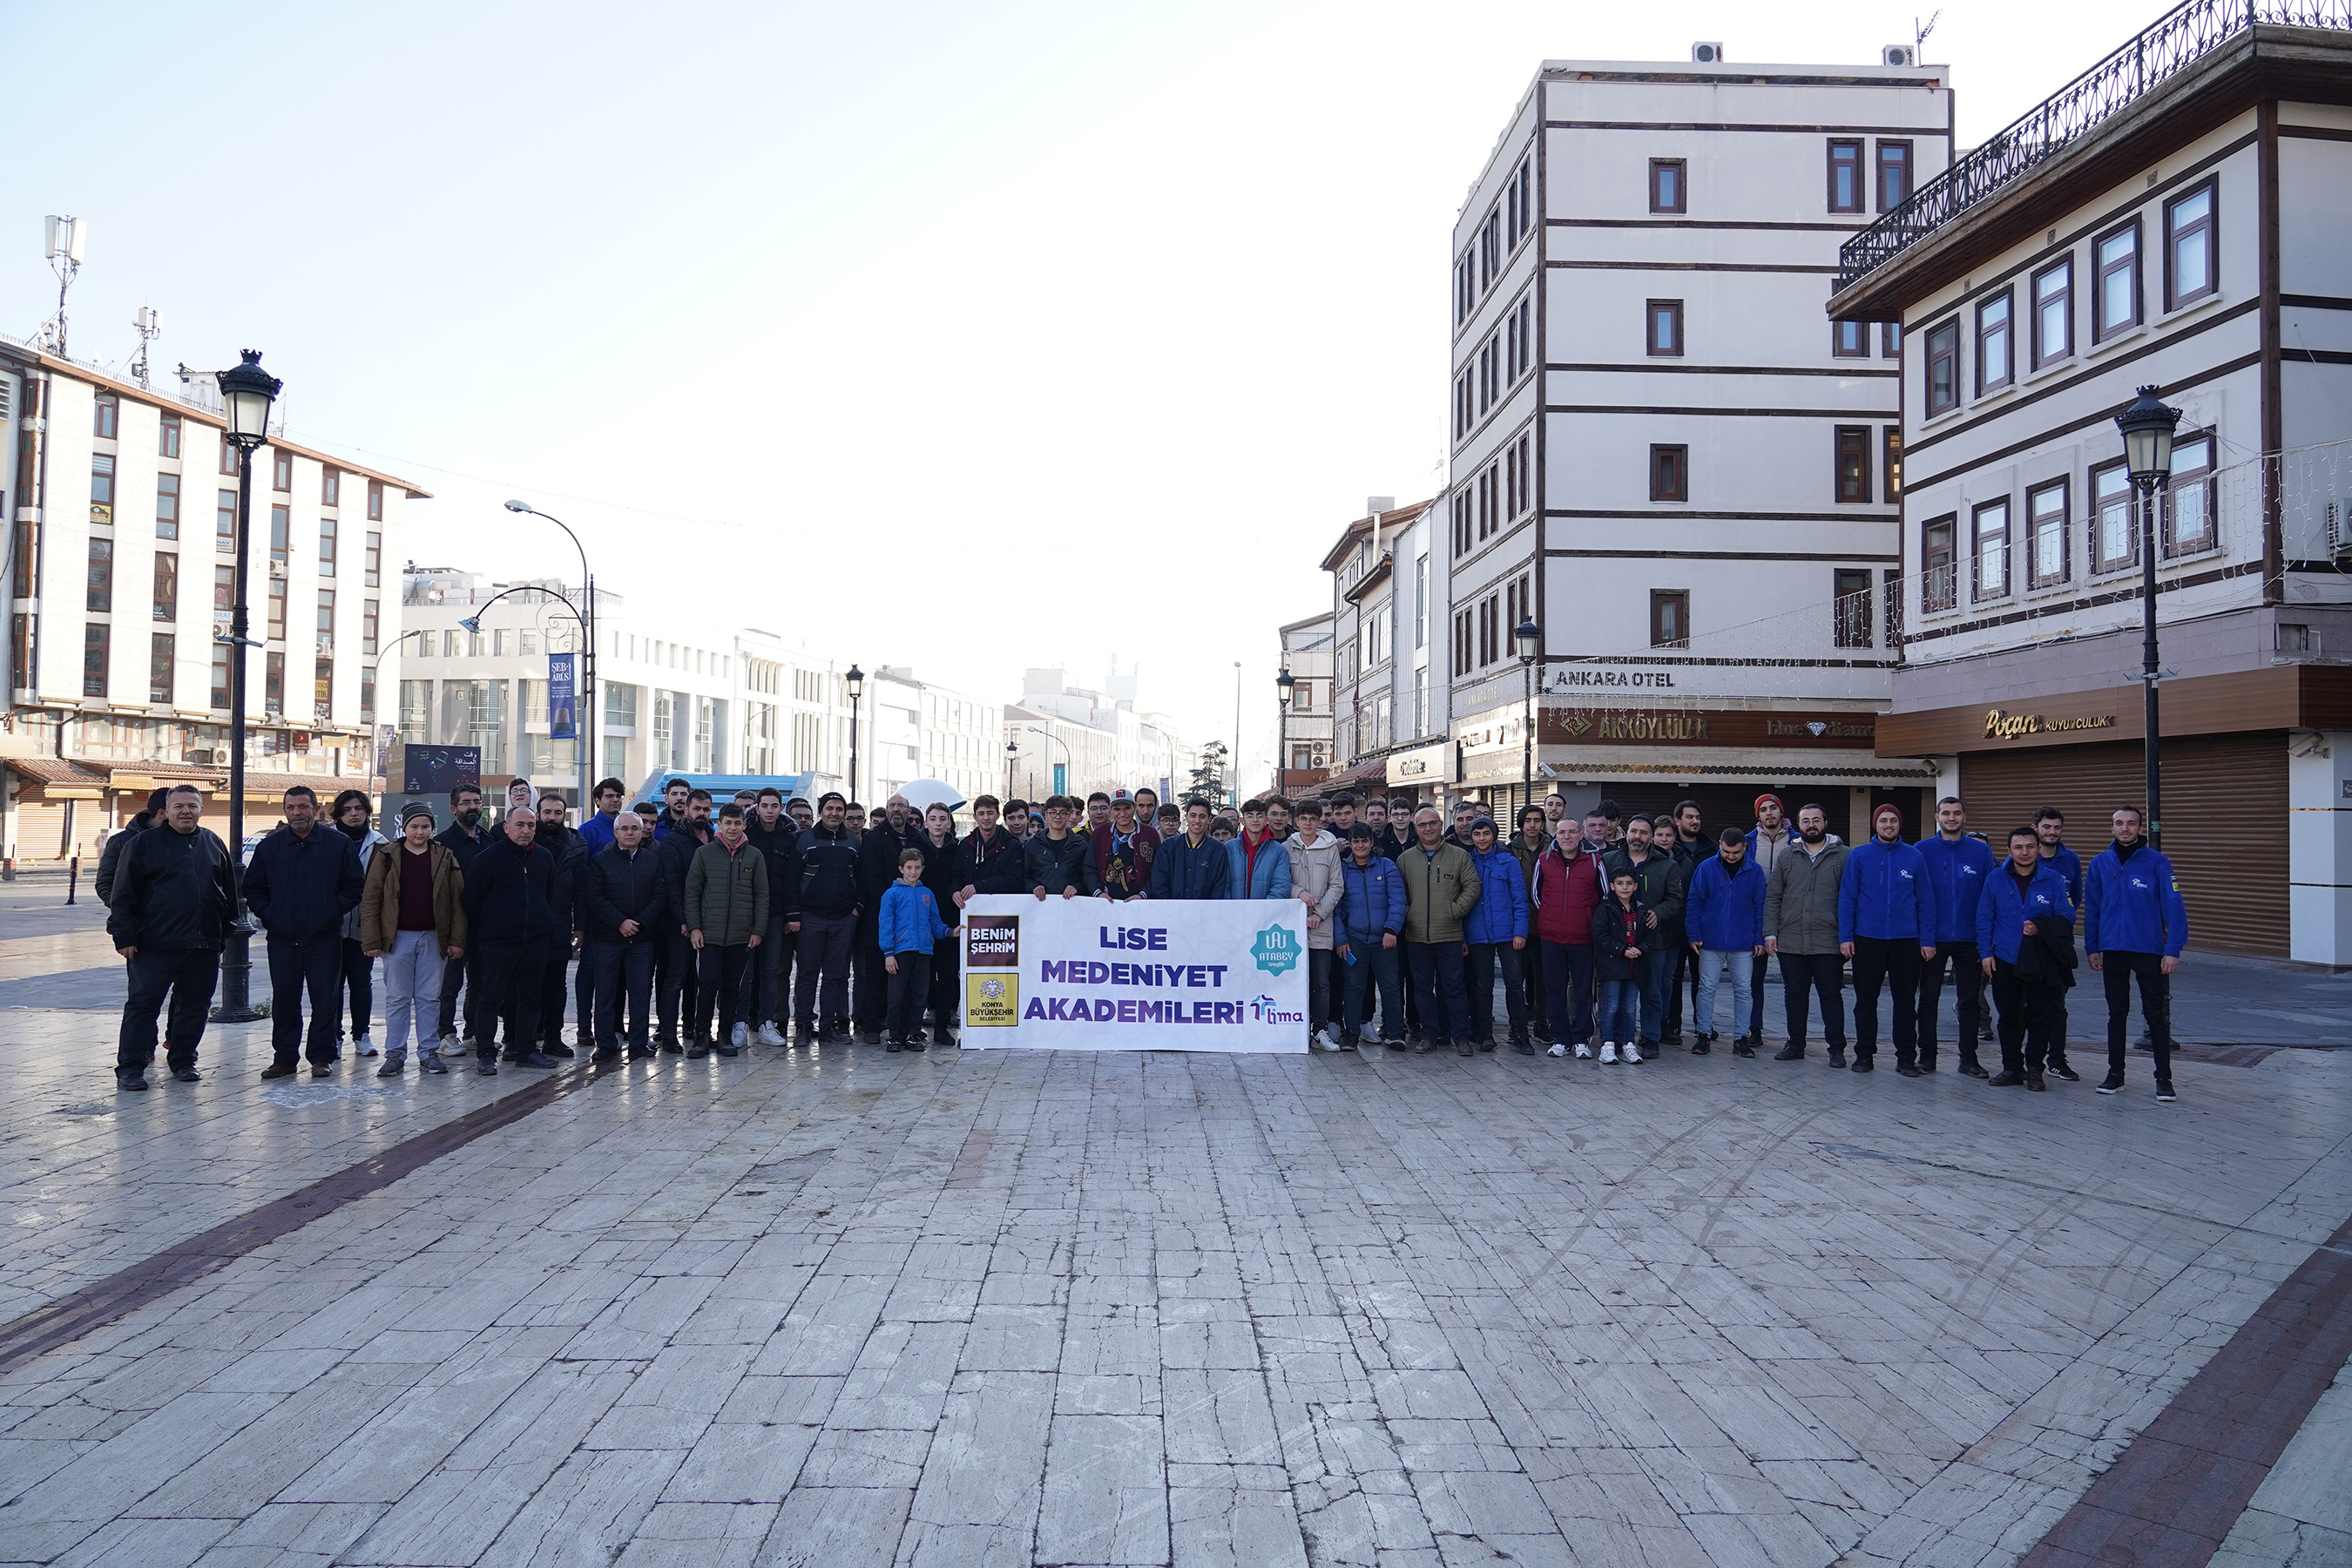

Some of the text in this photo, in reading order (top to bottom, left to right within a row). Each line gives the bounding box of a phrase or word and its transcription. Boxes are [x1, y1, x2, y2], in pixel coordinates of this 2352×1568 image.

[1556, 671, 1675, 687] ANKARA OTEL
[1598, 713, 1708, 740] AKKÖYLÜLER
[1767, 720, 1804, 736] blue
[1259, 952, 1294, 961] ATABEY
[970, 1007, 1014, 1017] BÜYÜKŞEHİR
